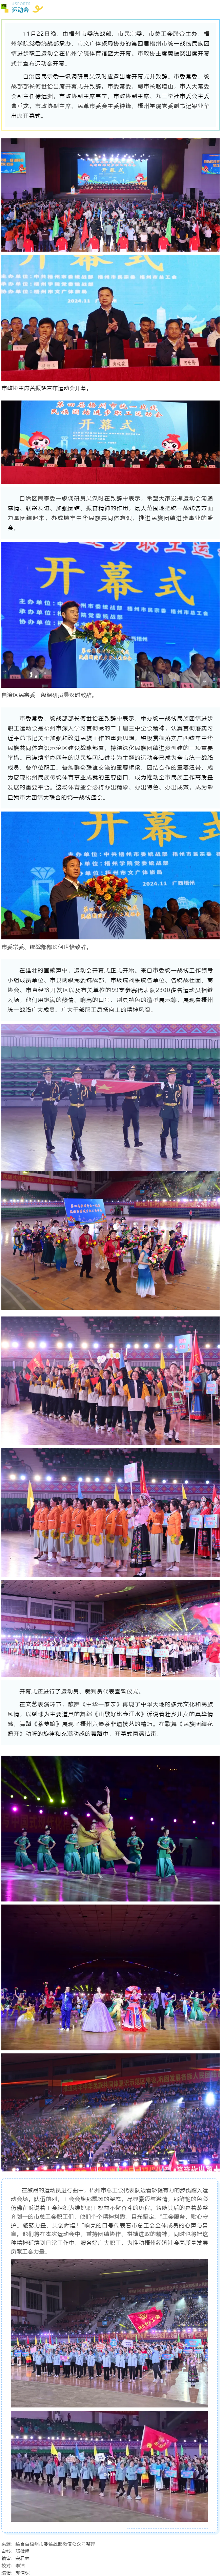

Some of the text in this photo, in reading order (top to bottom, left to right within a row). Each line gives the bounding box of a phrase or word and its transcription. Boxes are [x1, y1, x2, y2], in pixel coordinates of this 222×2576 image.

[56, 401, 158, 411] 第四届梧州市统一战线
[51, 409, 163, 418] 民族团结进步职工运动会
[78, 419, 135, 432] 开幕式
[35, 557, 195, 606] 开幕式
[138, 2315, 160, 2330] 梧州市总工会
